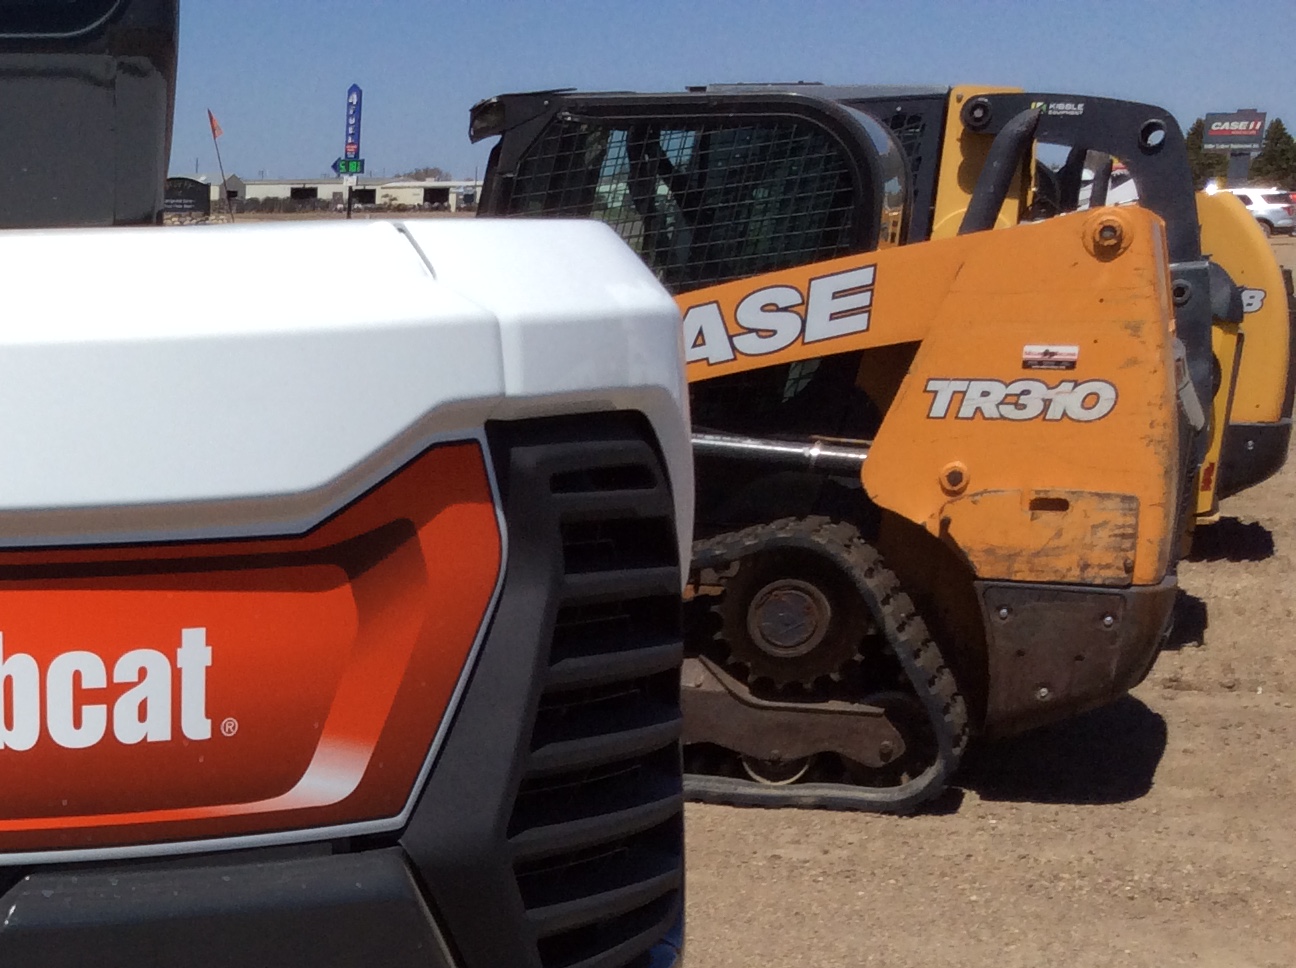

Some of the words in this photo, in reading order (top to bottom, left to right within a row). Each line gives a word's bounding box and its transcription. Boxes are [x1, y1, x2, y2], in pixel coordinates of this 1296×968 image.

[1211, 121, 1249, 131] CASE
[683, 263, 877, 367] ASE
[1241, 288, 1267, 314] B
[924, 377, 1119, 423] TR310
